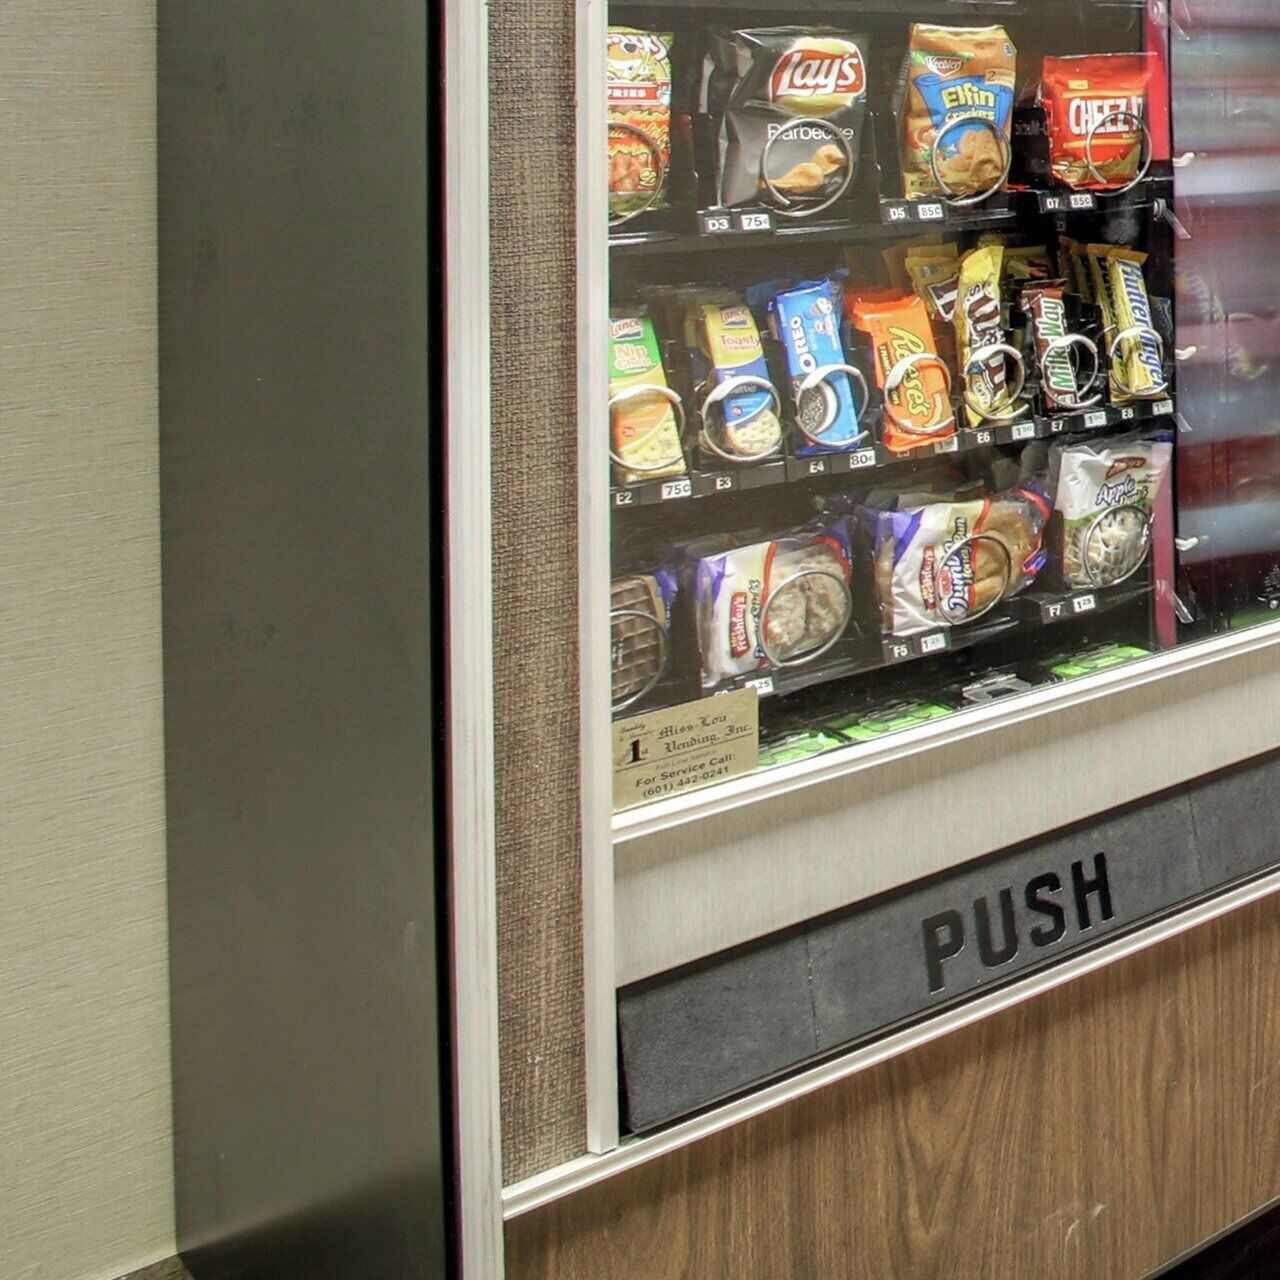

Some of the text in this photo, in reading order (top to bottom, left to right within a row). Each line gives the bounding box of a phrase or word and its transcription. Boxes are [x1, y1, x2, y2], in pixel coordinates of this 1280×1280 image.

[777, 52, 860, 98] Lay's
[942, 82, 996, 109] Elfin
[1046, 198, 1060, 210] D7
[890, 206, 906, 219] D5
[708, 218, 729, 231] D3
[1041, 298, 1066, 342] Way
[1121, 259, 1164, 387] Butteringer
[790, 316, 818, 374] OREO
[1121, 408, 1135, 420] E8
[1051, 421, 1063, 432] E7
[977, 432, 991, 444] E6
[810, 461, 826, 474] E4
[716, 477, 732, 490] E3
[1095, 475, 1136, 506] Apple
[616, 493, 633, 506] E2
[1050, 605, 1063, 617] F7
[894, 646, 908, 658] F5
[636, 752, 737, 789] For Service Call:
[643, 766, 730, 799] (601) 442-0241
[922, 851, 1115, 995] PUSH
